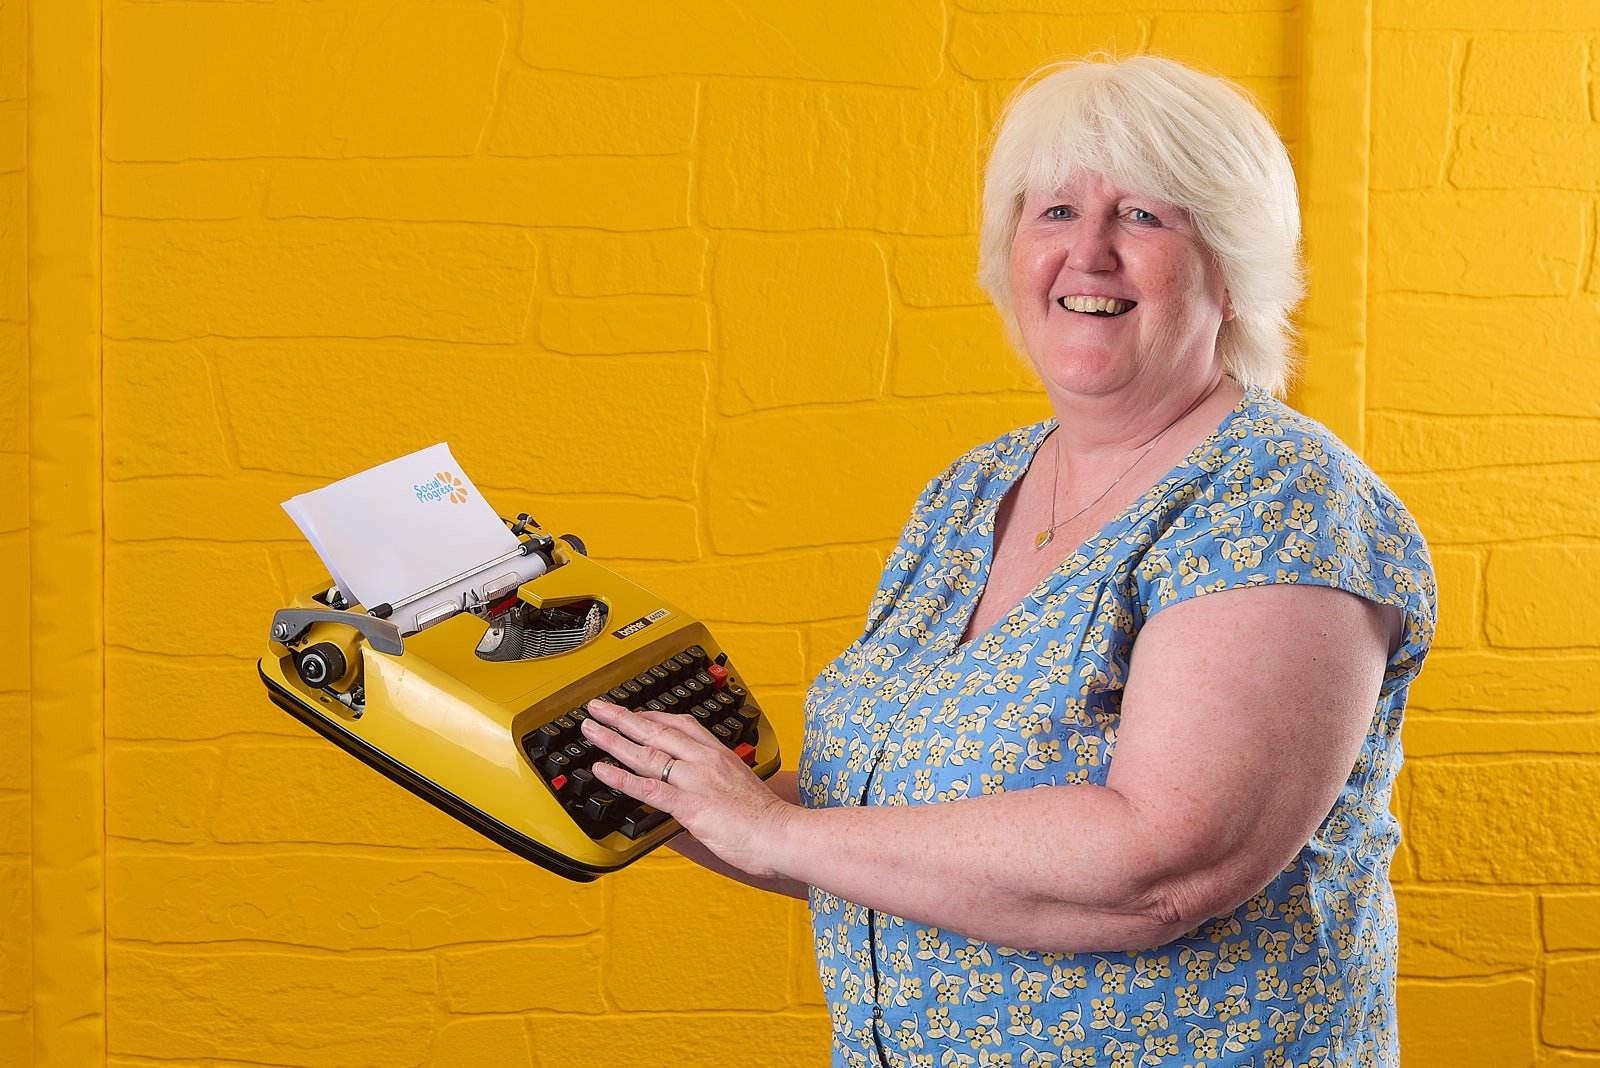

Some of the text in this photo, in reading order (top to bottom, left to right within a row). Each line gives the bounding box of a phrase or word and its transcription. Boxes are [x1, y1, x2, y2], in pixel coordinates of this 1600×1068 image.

[413, 476, 442, 495] Social
[416, 484, 454, 504] Progress
[617, 621, 647, 637] brother
